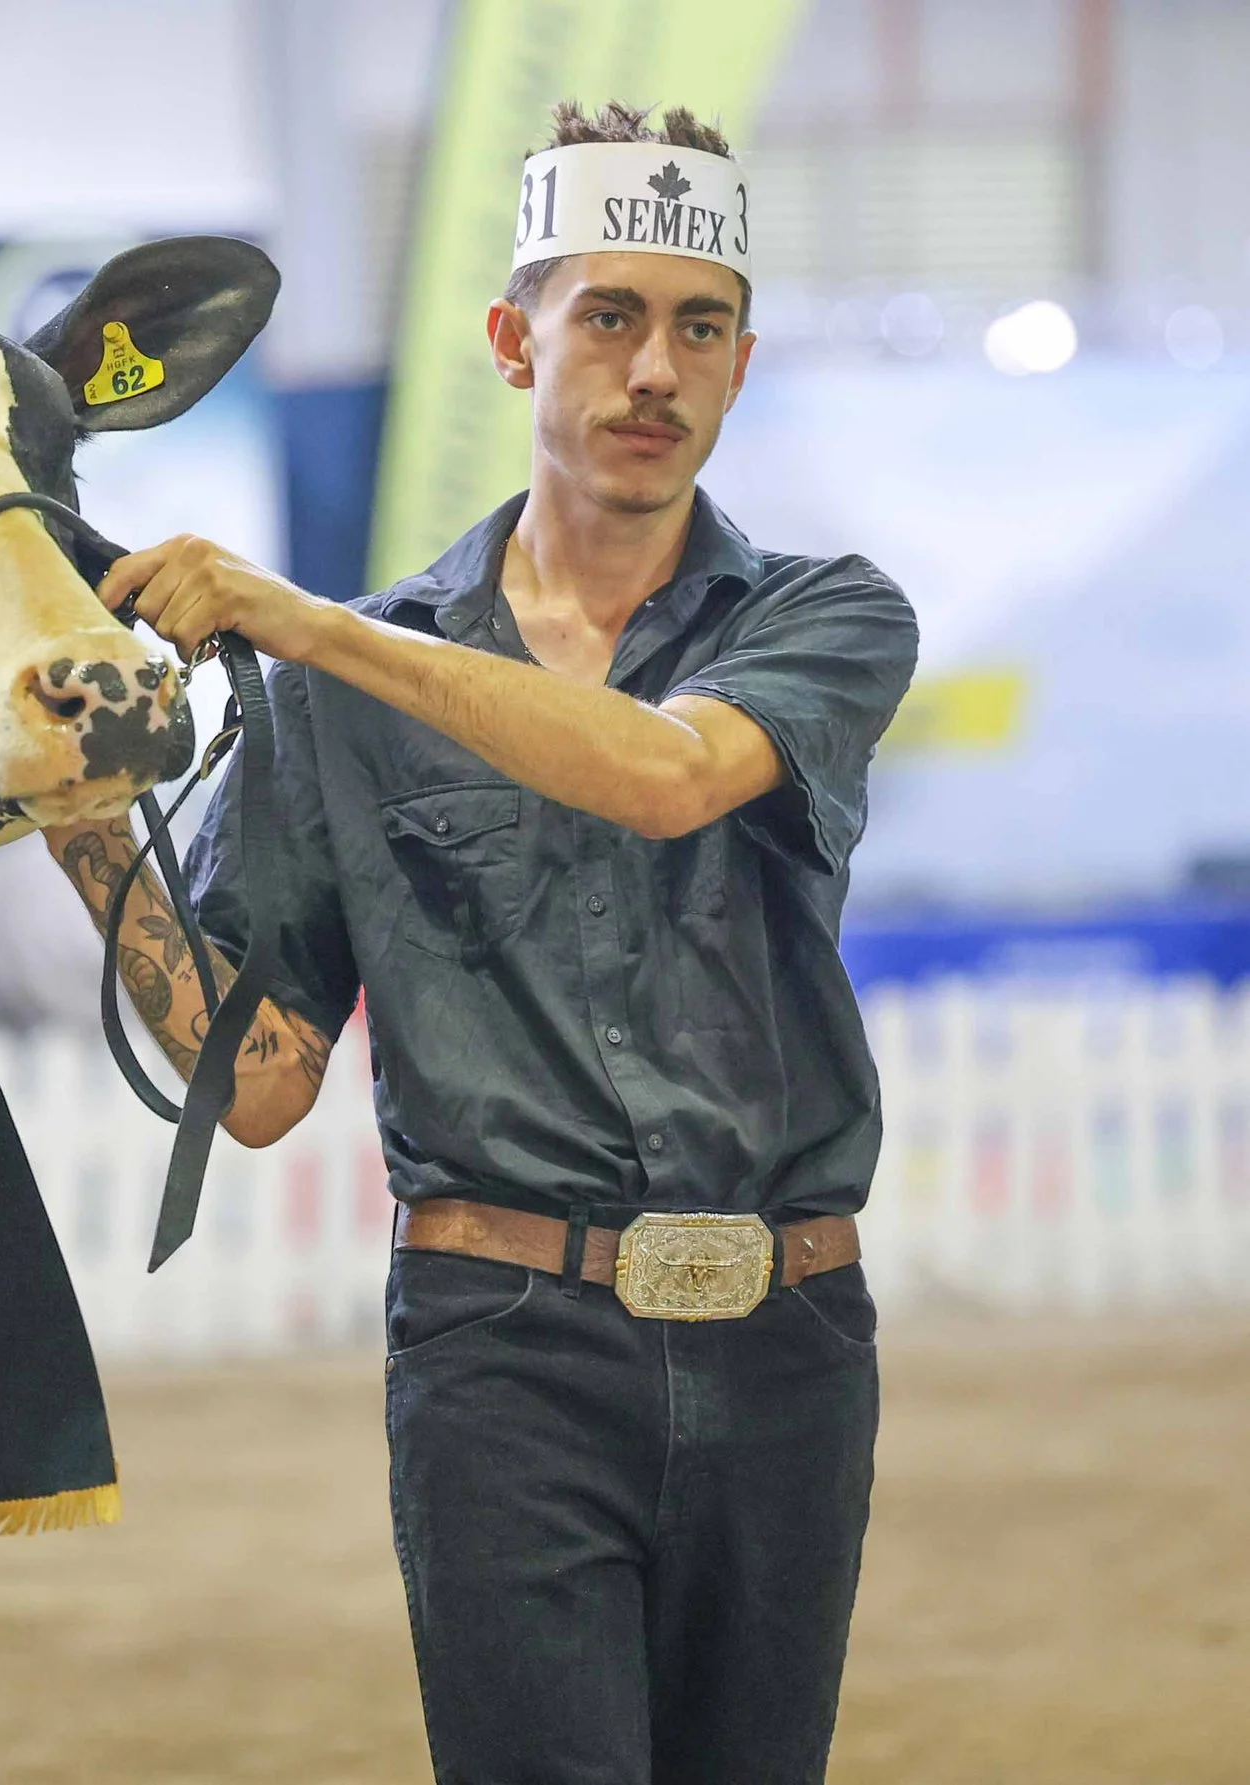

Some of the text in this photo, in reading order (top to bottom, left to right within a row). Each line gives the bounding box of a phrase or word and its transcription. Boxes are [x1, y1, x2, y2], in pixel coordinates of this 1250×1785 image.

[517, 165, 559, 249] 31
[603, 197, 726, 256] SEMEX
[112, 365, 146, 395] 62
